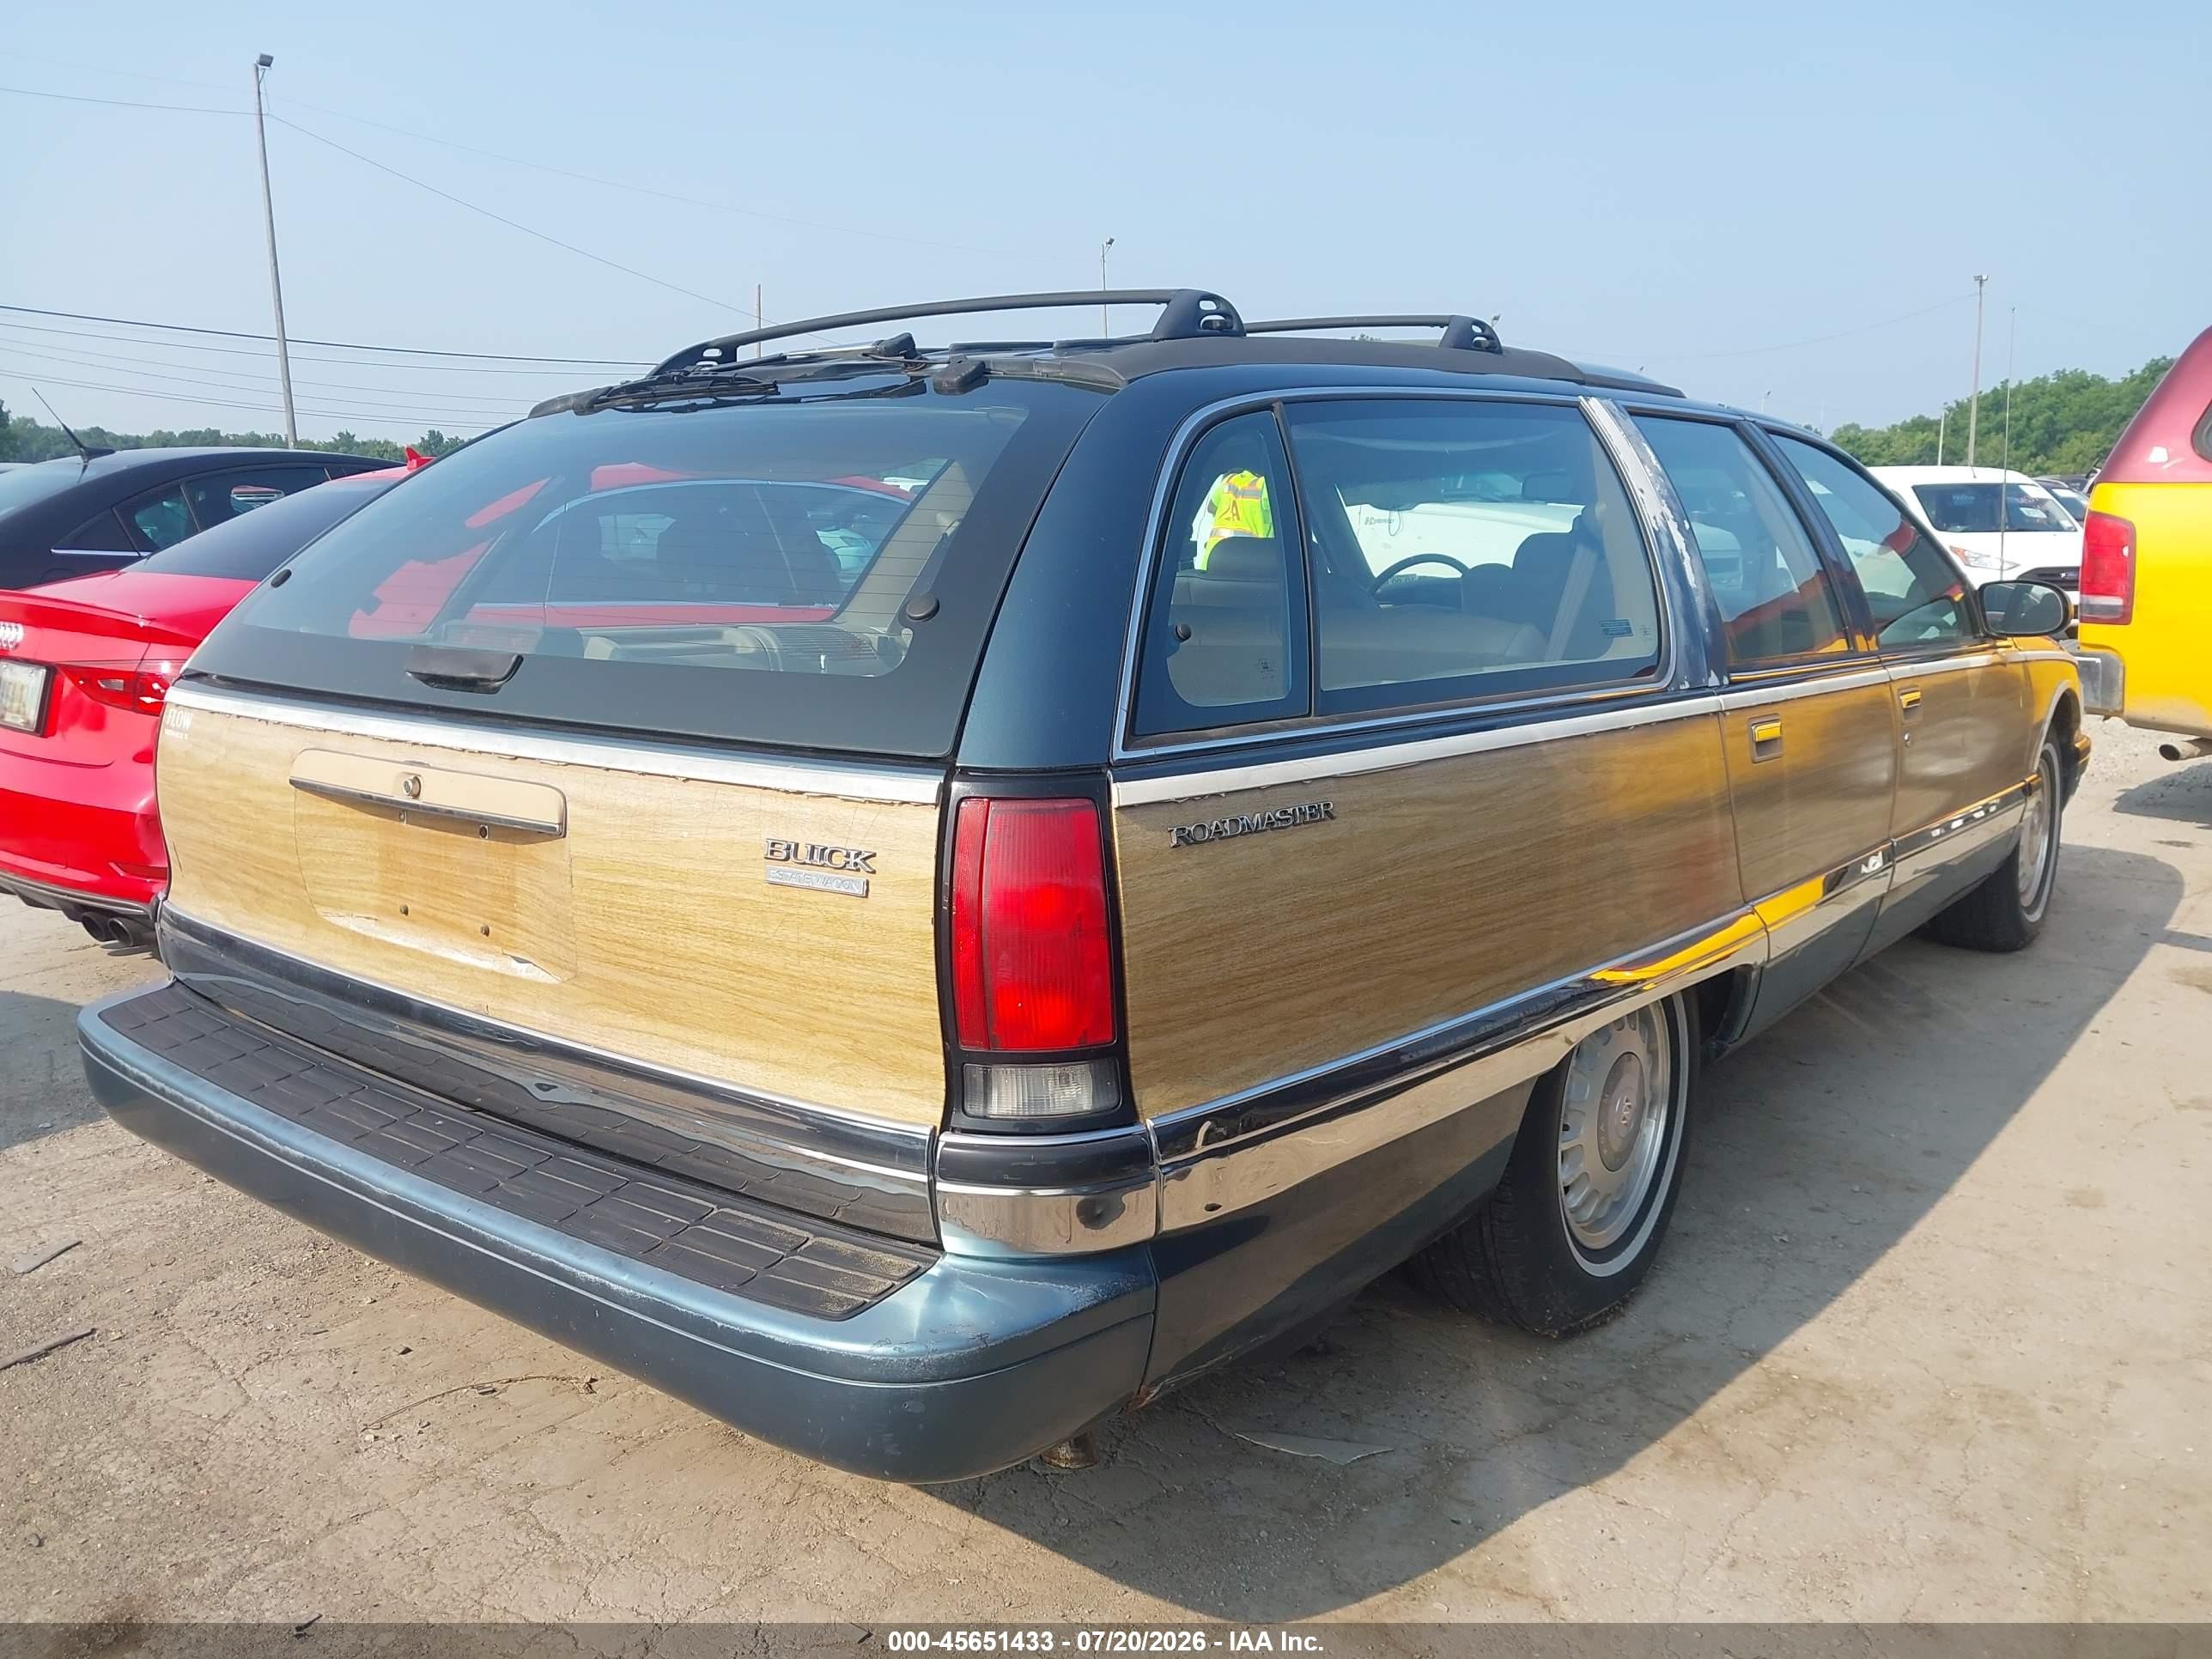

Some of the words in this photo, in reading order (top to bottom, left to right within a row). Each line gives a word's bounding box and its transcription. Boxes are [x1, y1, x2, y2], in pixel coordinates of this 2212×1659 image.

[166, 708, 193, 729] FLOW
[1167, 799, 1337, 848] ROADMASTER
[763, 837, 878, 874] BUICK
[769, 868, 812, 887] ESTATE
[815, 875, 861, 894] WAGON
